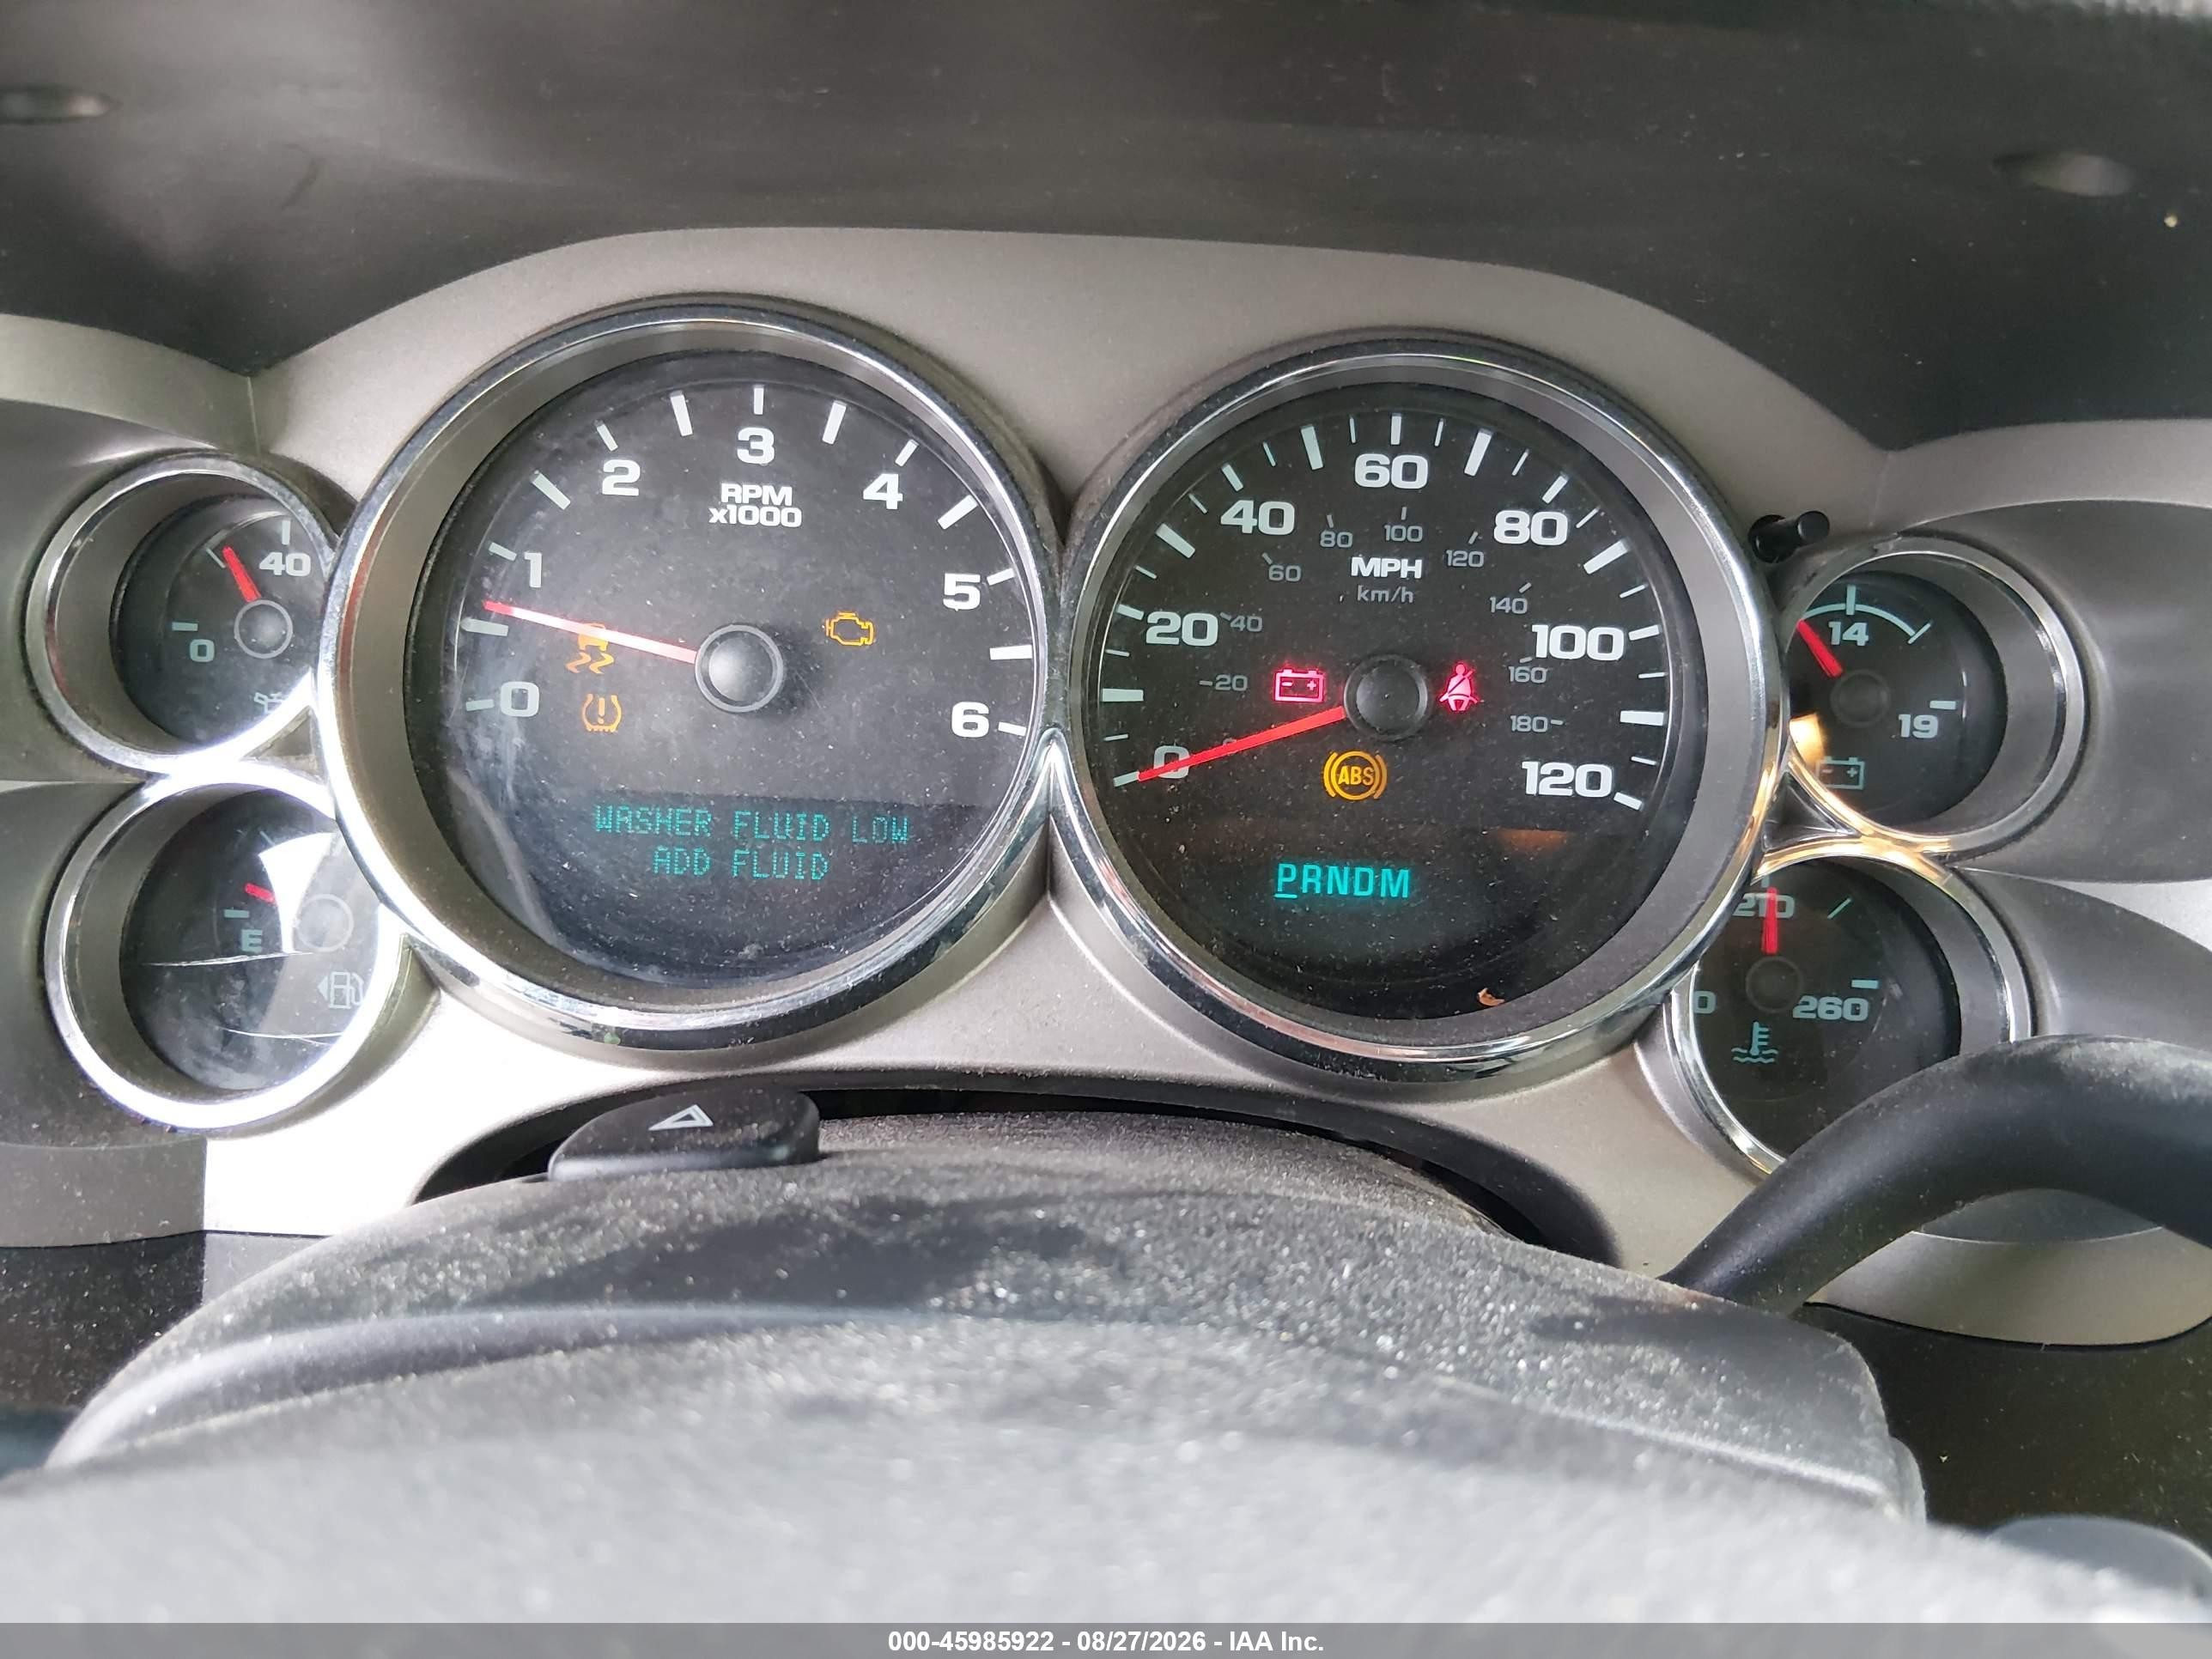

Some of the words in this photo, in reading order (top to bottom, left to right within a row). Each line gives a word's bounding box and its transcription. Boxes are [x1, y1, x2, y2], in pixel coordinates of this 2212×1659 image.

[738, 428, 775, 465] 3
[602, 459, 640, 496] 2
[1354, 453, 1429, 489] 60
[720, 483, 793, 505] RPM
[863, 473, 903, 509] 4
[708, 506, 802, 528] x1000
[1220, 500, 1296, 536] 40
[1493, 510, 1568, 545] 80
[1319, 531, 1353, 549] 80
[1384, 525, 1423, 543] 100
[259, 552, 311, 576] 40
[524, 552, 542, 588] 1
[1351, 557, 1422, 579] MPH
[1446, 550, 1485, 568] 120
[1268, 565, 1302, 582] 60
[944, 573, 981, 611] 5
[1357, 586, 1414, 603] km/h
[1489, 597, 1528, 615] 140
[1146, 611, 1218, 647] 20
[1230, 616, 1262, 633] 40
[1828, 621, 1869, 647] 14
[189, 639, 215, 662] 0
[1531, 624, 1625, 660] 100
[1215, 675, 1249, 692] 20
[1509, 666, 1547, 684] 160
[499, 682, 540, 718] 0
[951, 702, 989, 738] 6
[1510, 714, 1547, 732] 180
[1898, 714, 1939, 739] 19
[1153, 745, 1190, 780] 0
[1337, 765, 1374, 784] ABS
[1521, 761, 1613, 797] 120
[594, 805, 711, 838] WASHER
[734, 811, 830, 841] FLUID
[852, 817, 909, 844] LOW
[653, 846, 710, 876] ADD
[731, 849, 830, 879] FLUID
[1276, 863, 1410, 898] PRNDM
[240, 929, 264, 953] E
[1792, 995, 1869, 1022] 260
